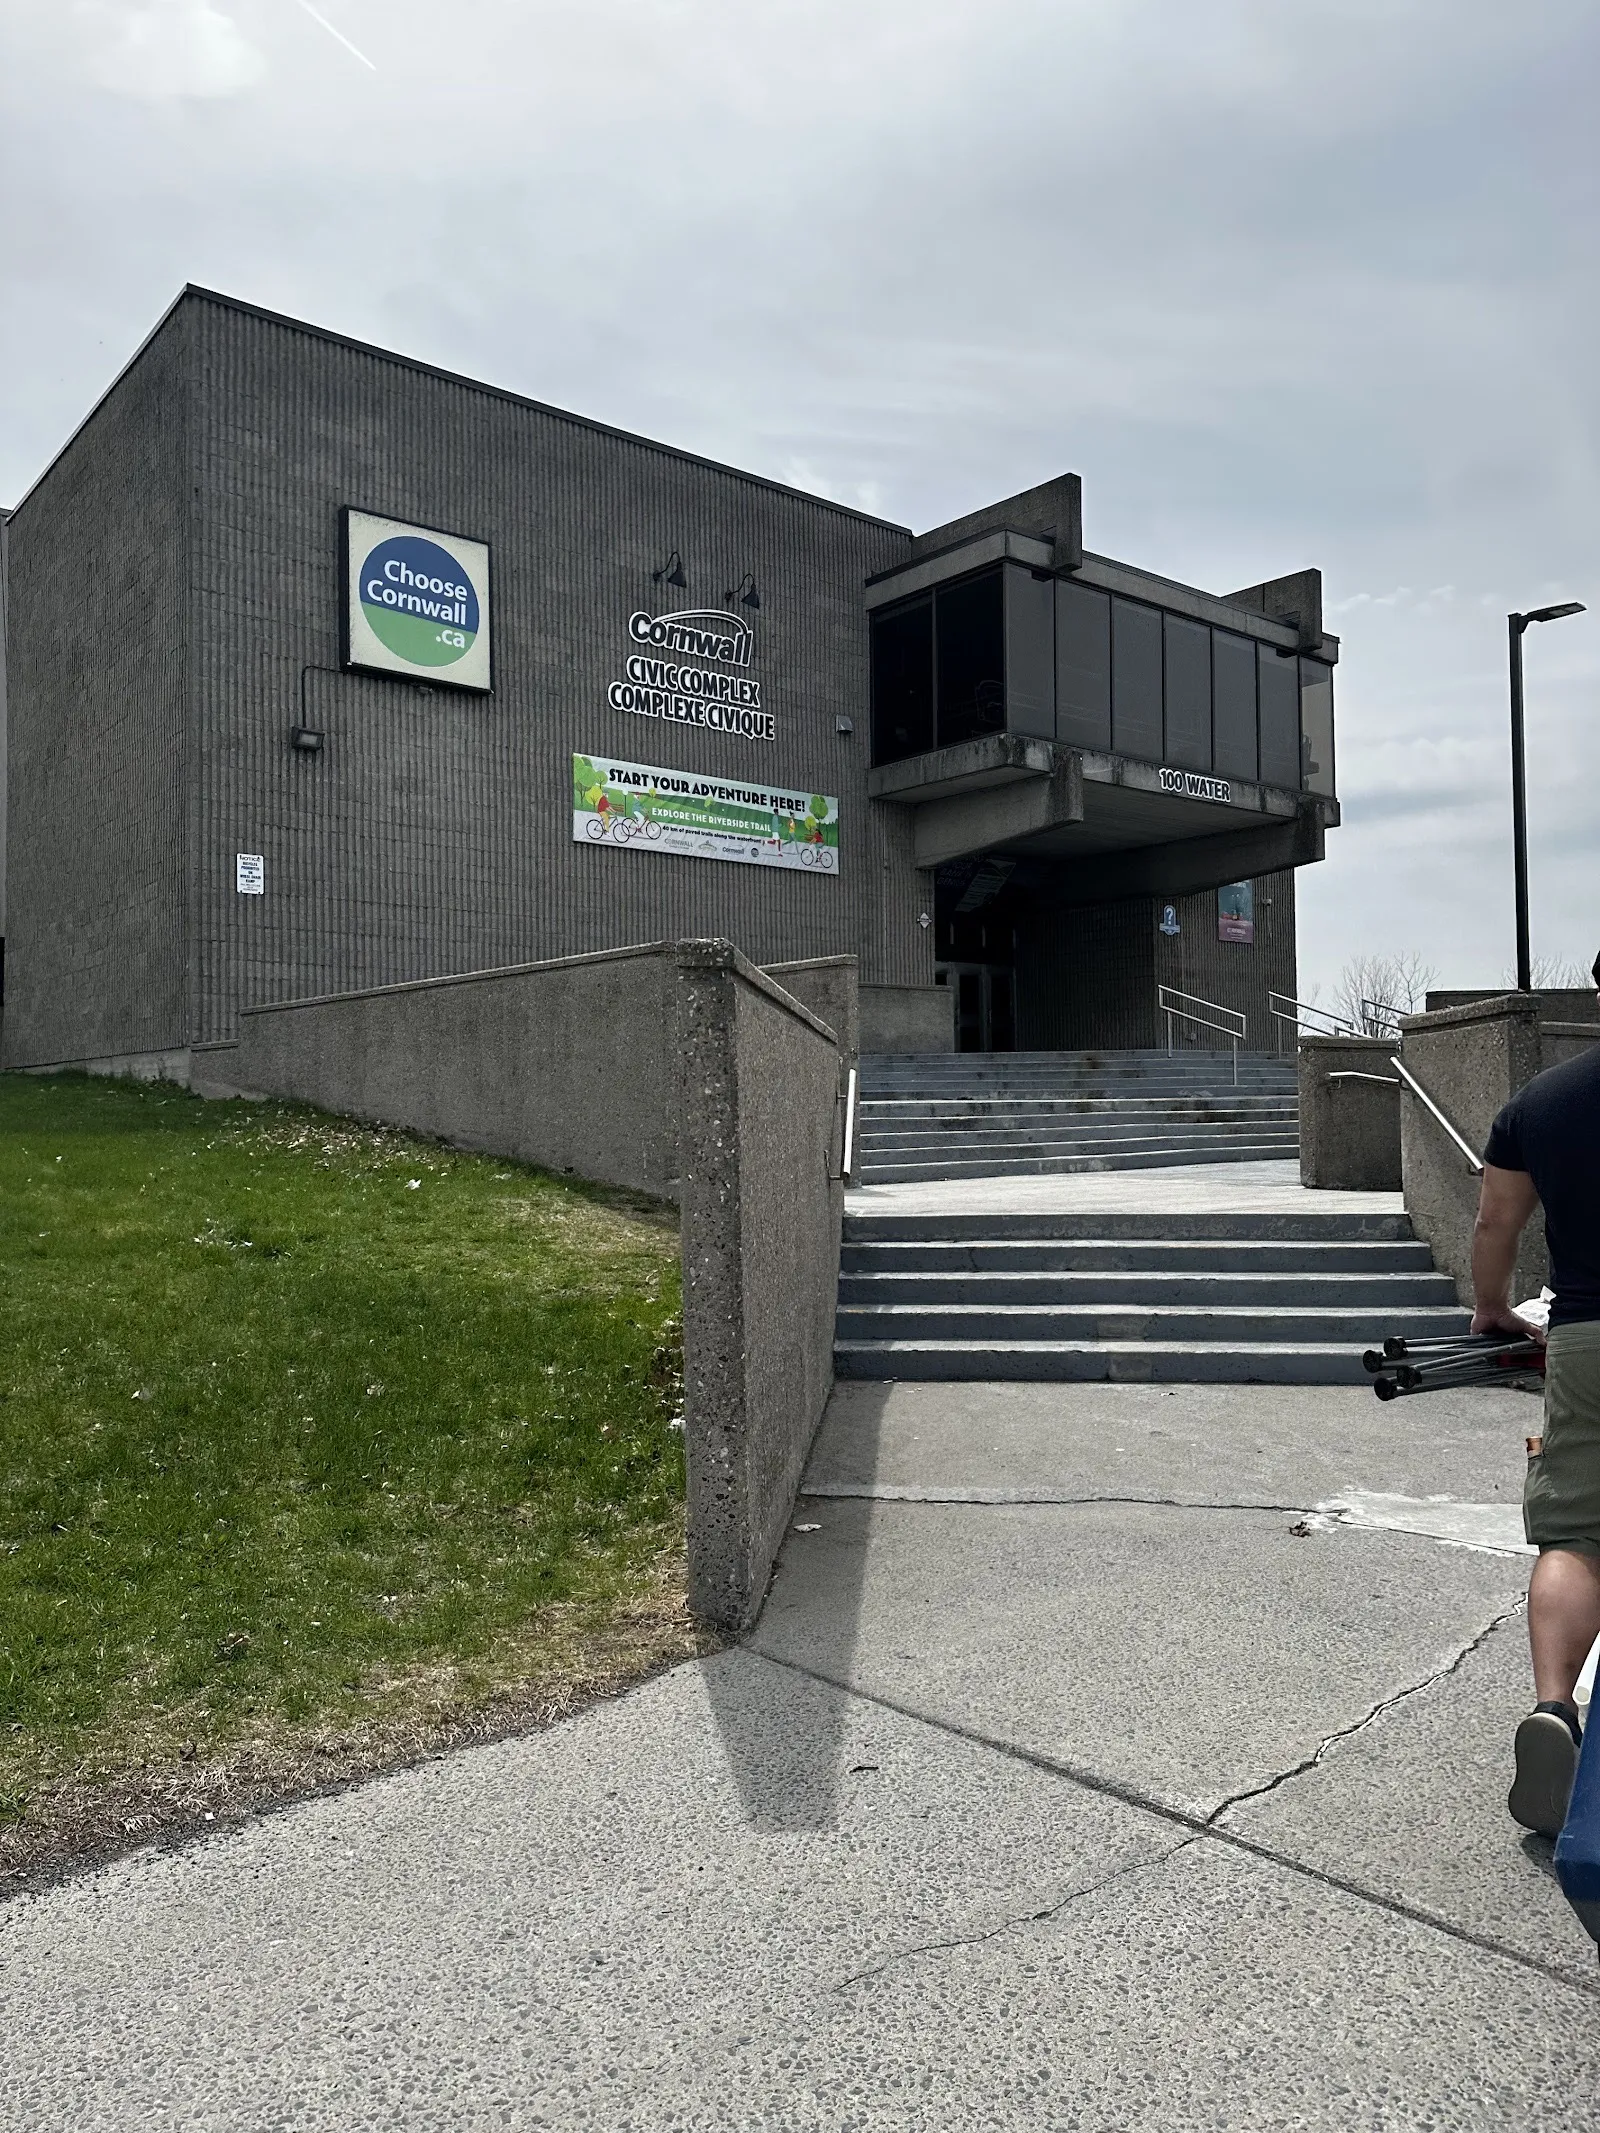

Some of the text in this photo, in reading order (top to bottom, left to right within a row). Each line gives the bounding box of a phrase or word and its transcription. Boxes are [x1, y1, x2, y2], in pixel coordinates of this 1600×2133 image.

[367, 579, 467, 625] Cornwall
[384, 559, 468, 601] Choose
[435, 629, 465, 648] .ca
[629, 611, 753, 667] Cornwall
[627, 655, 760, 708] CIVIC COMPLEX
[608, 682, 775, 740] COMPLEXE CIVIQUE
[609, 768, 805, 812] START YOUR ADVENTURE HERE!
[1159, 768, 1231, 803] 100 WATER
[652, 807, 772, 832] EXPLORE THE RIVERSIDE TRAIL
